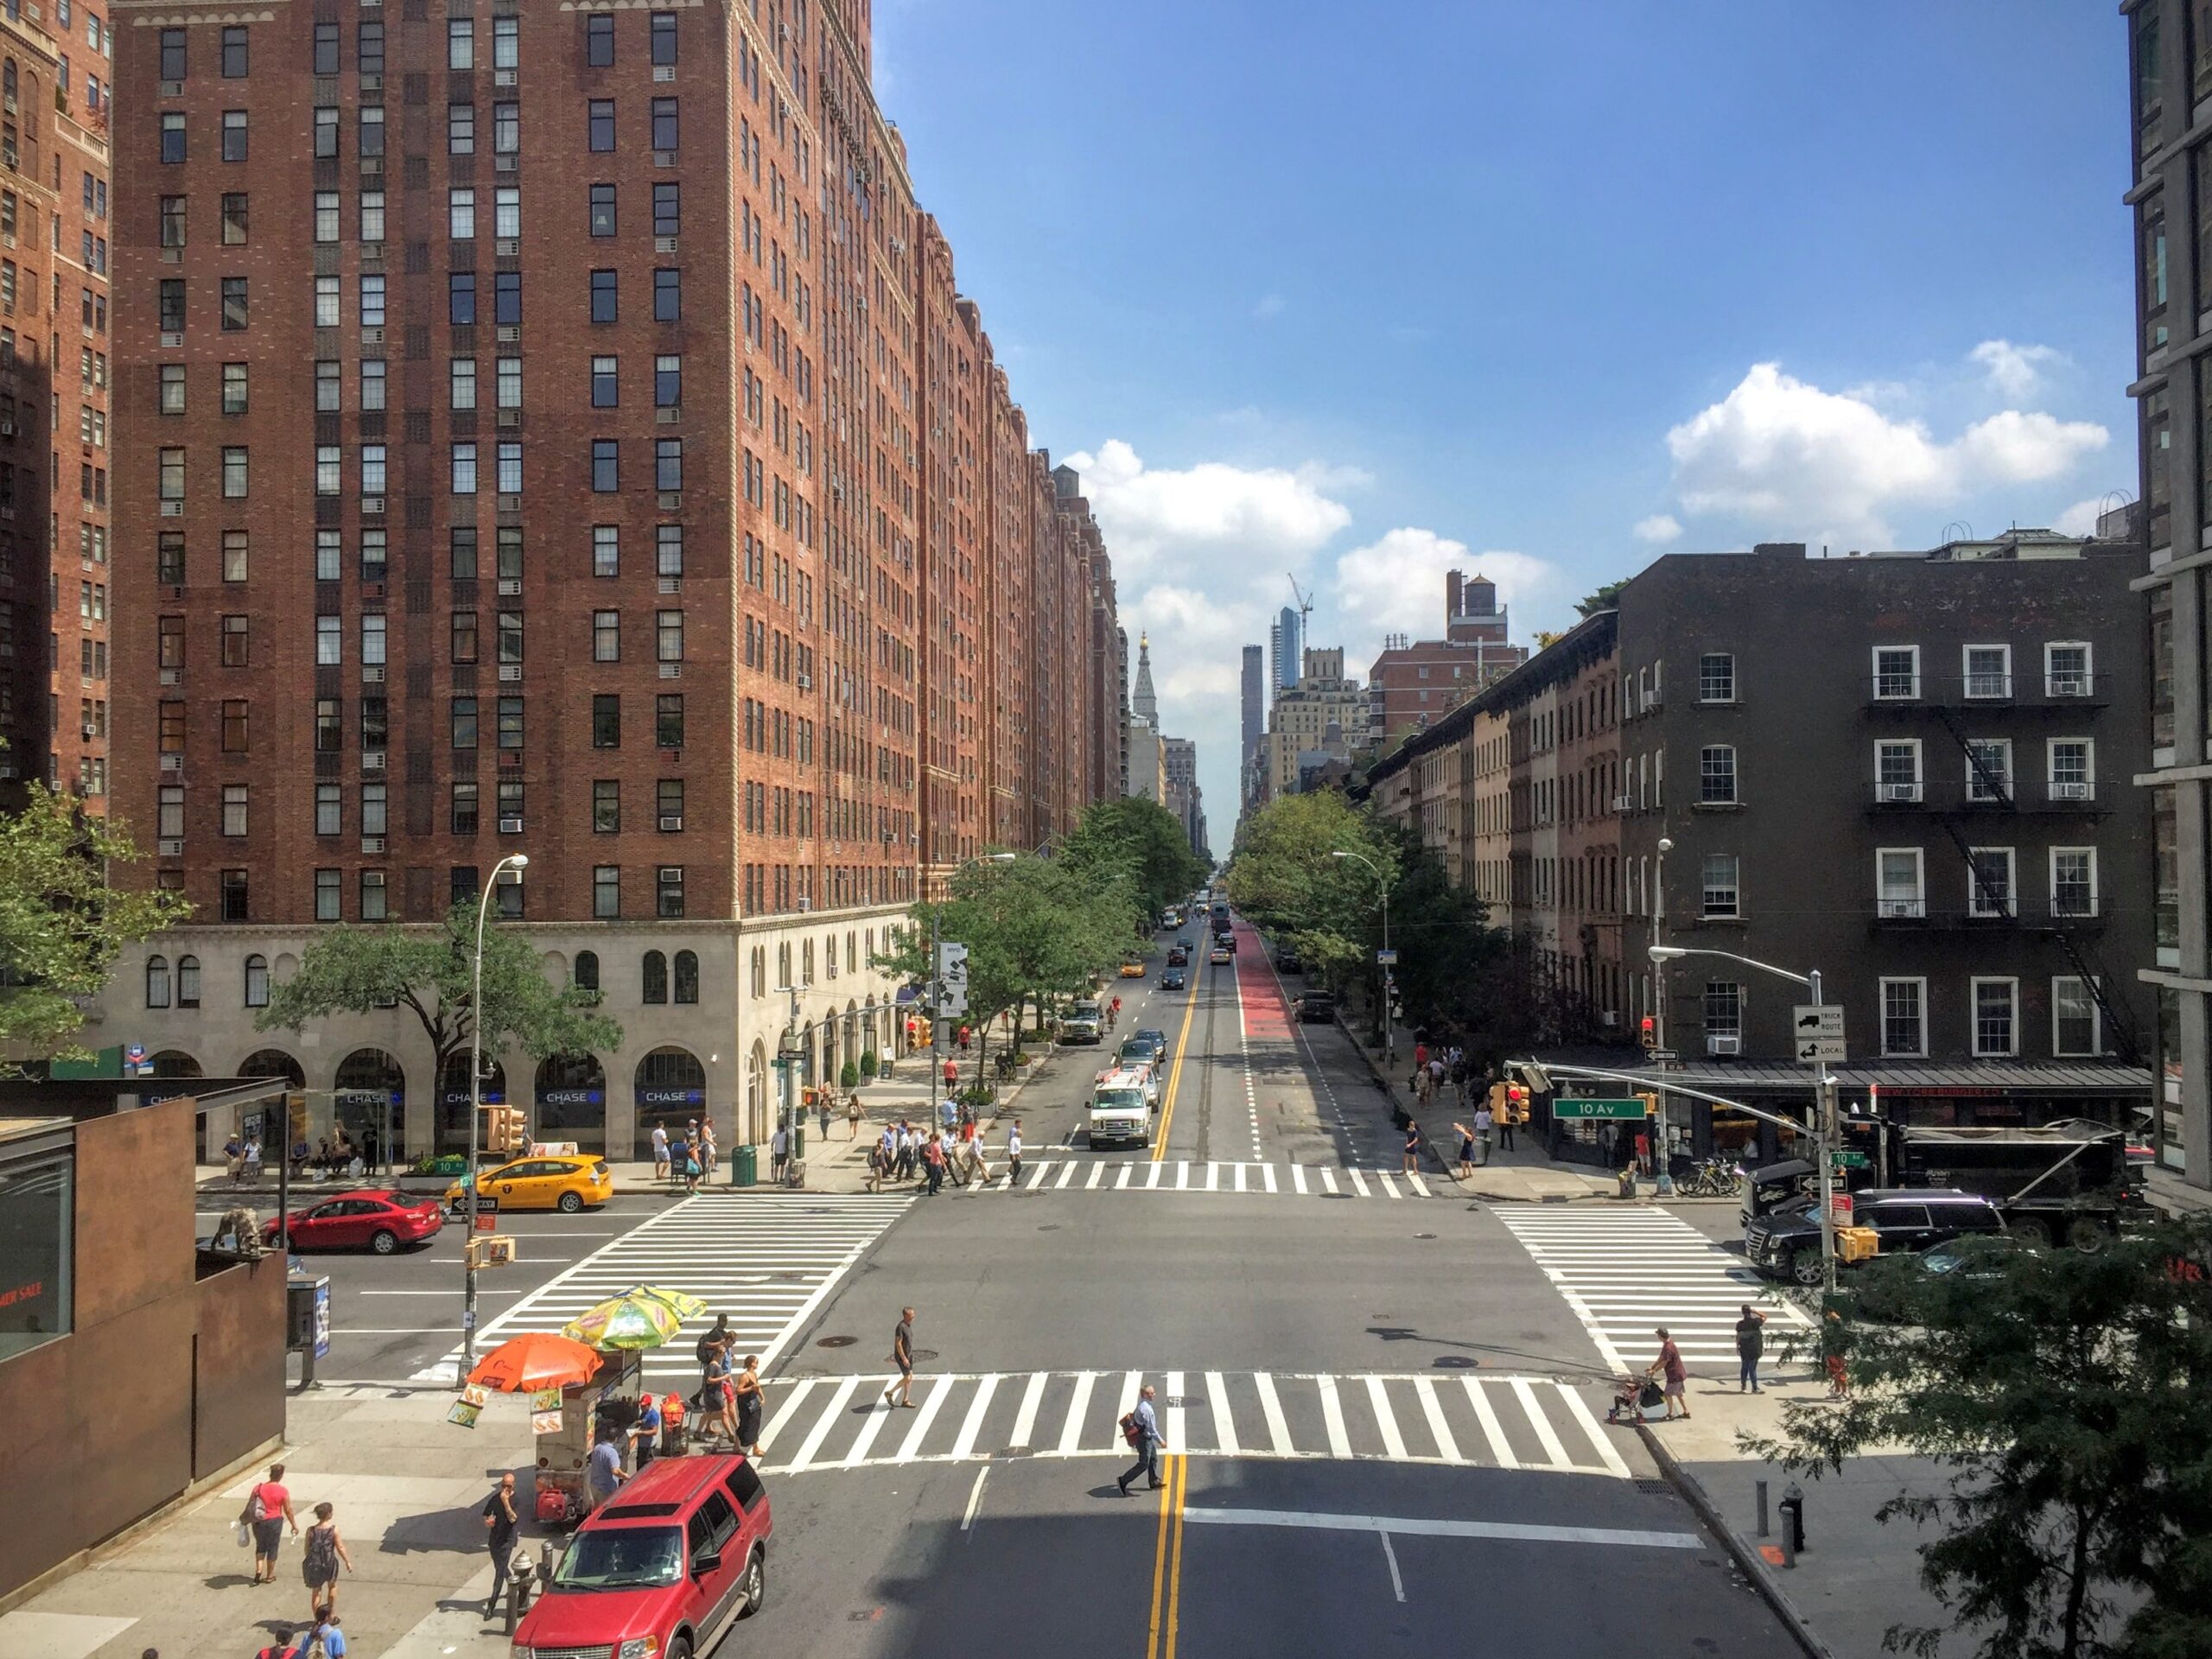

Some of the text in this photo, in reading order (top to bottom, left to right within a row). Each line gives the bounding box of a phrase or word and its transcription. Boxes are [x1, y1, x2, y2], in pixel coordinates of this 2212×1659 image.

[347, 1095, 386, 1103] CHASE
[447, 1093, 486, 1103] CHAE
[546, 1093, 587, 1103] CHASE
[646, 1092, 686, 1102] CHASE
[1579, 1104, 1614, 1114] 10 Av
[1836, 1154, 1847, 1164] 10
[440, 1162, 450, 1172] 10
